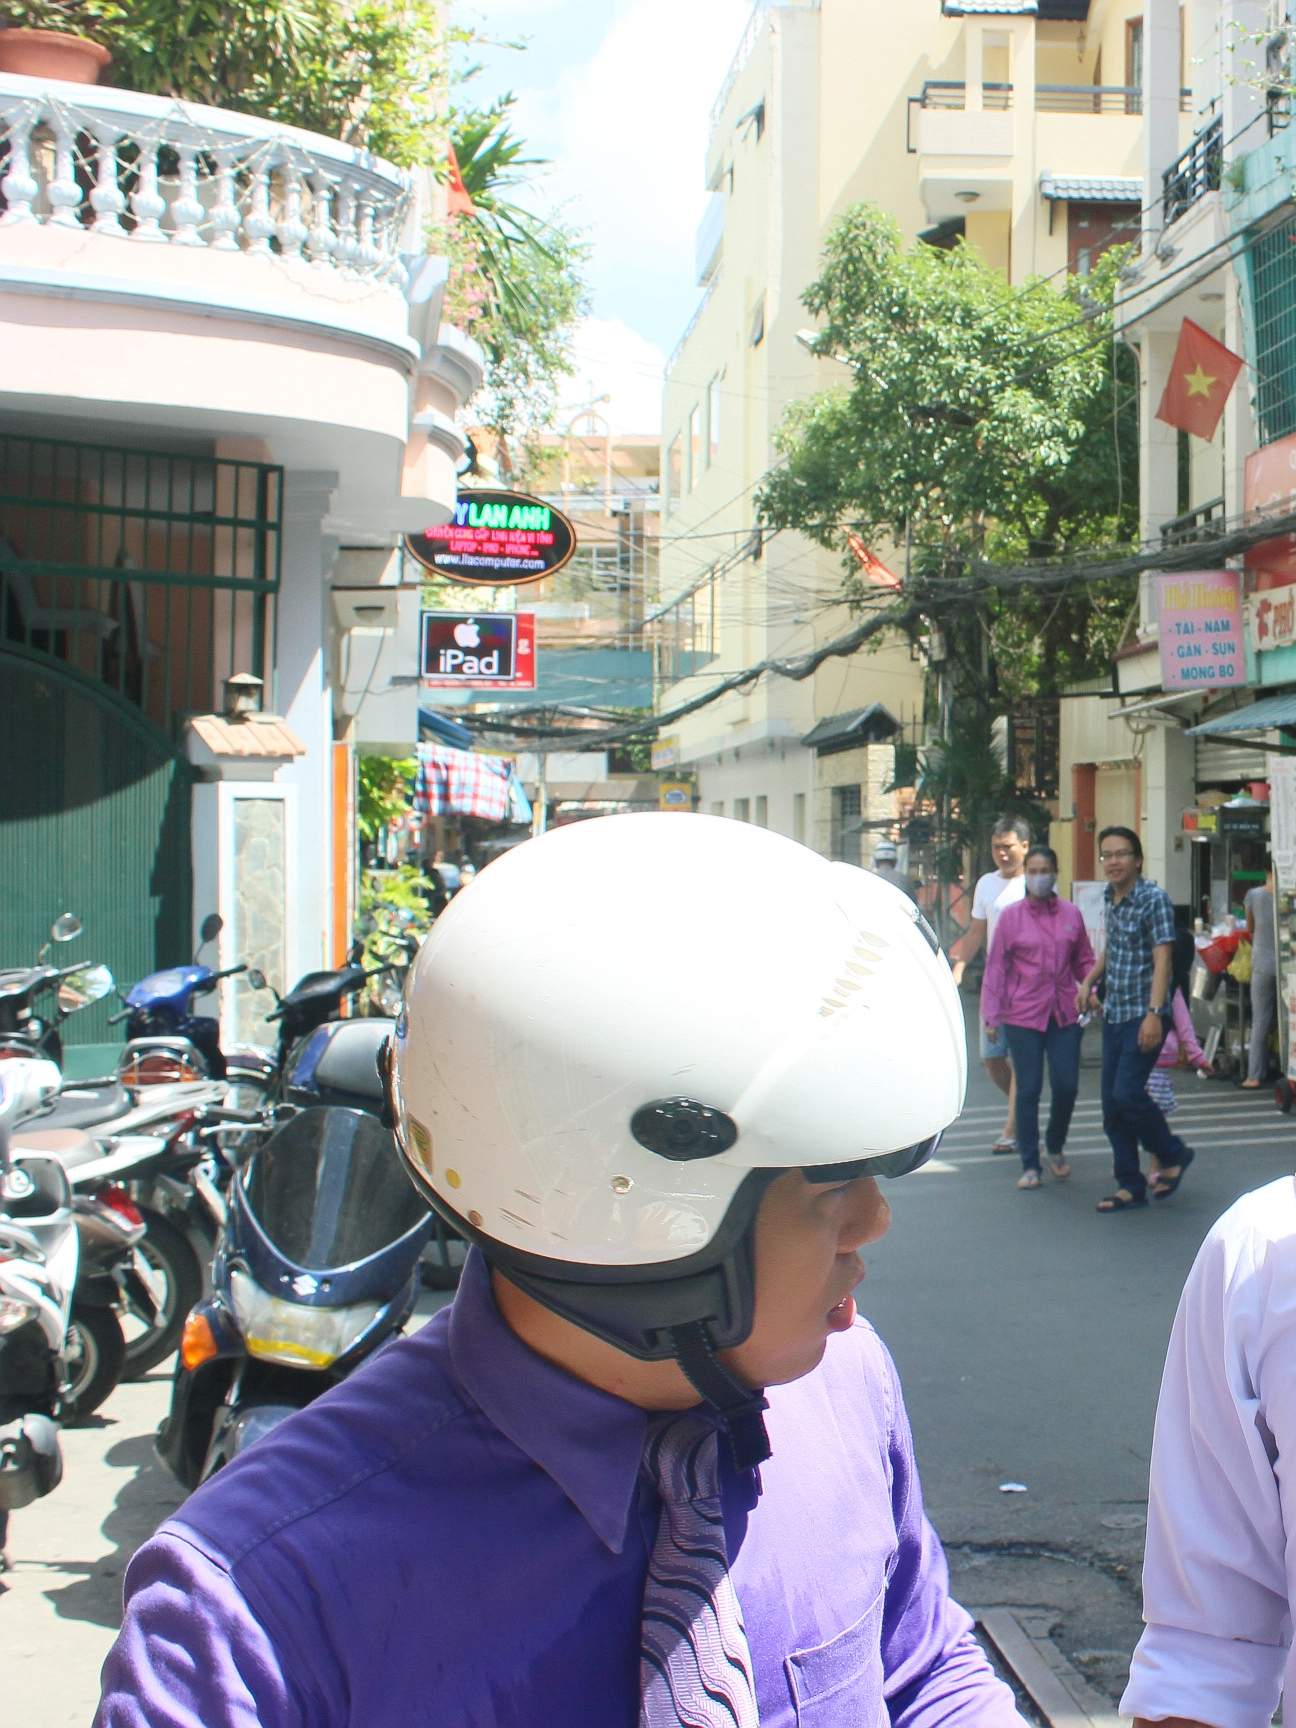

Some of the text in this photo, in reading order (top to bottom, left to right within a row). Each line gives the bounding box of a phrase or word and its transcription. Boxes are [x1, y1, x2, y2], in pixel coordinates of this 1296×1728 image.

[469, 503, 508, 528] LAN
[508, 505, 550, 530] ANH
[439, 649, 499, 674] iPad
